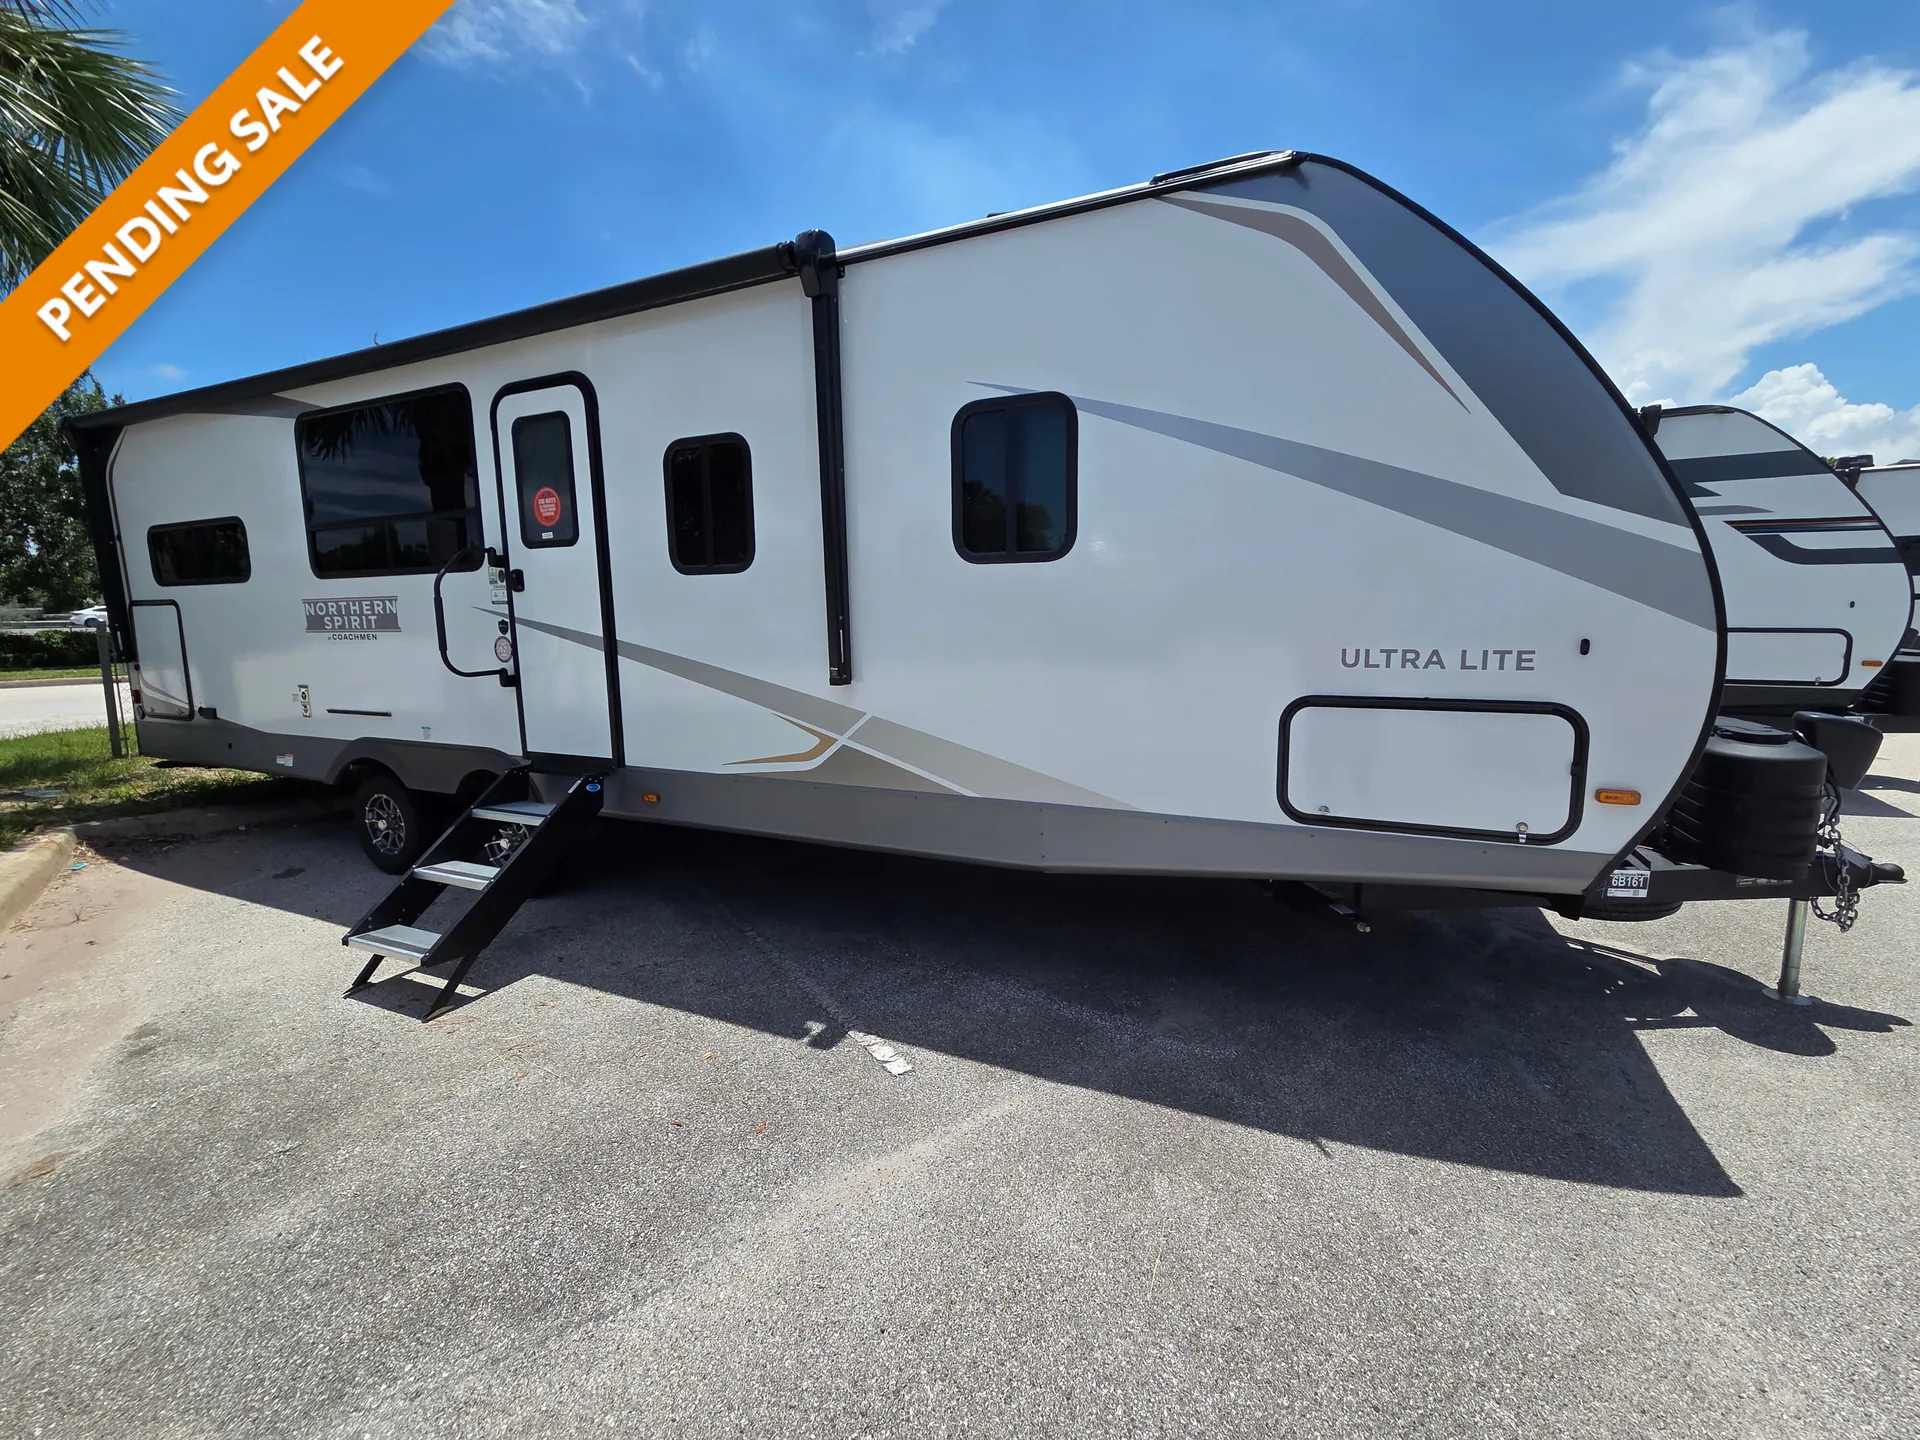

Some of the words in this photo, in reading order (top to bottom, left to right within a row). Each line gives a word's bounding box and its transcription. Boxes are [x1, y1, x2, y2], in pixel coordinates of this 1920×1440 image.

[305, 600, 397, 616] NORTHERN
[324, 616, 378, 630] SPIRIT
[332, 633, 378, 641] COACHMEN
[1341, 648, 1446, 669] ULTRA
[1460, 649, 1536, 671] LITE
[1611, 876, 1644, 887] 6B161
